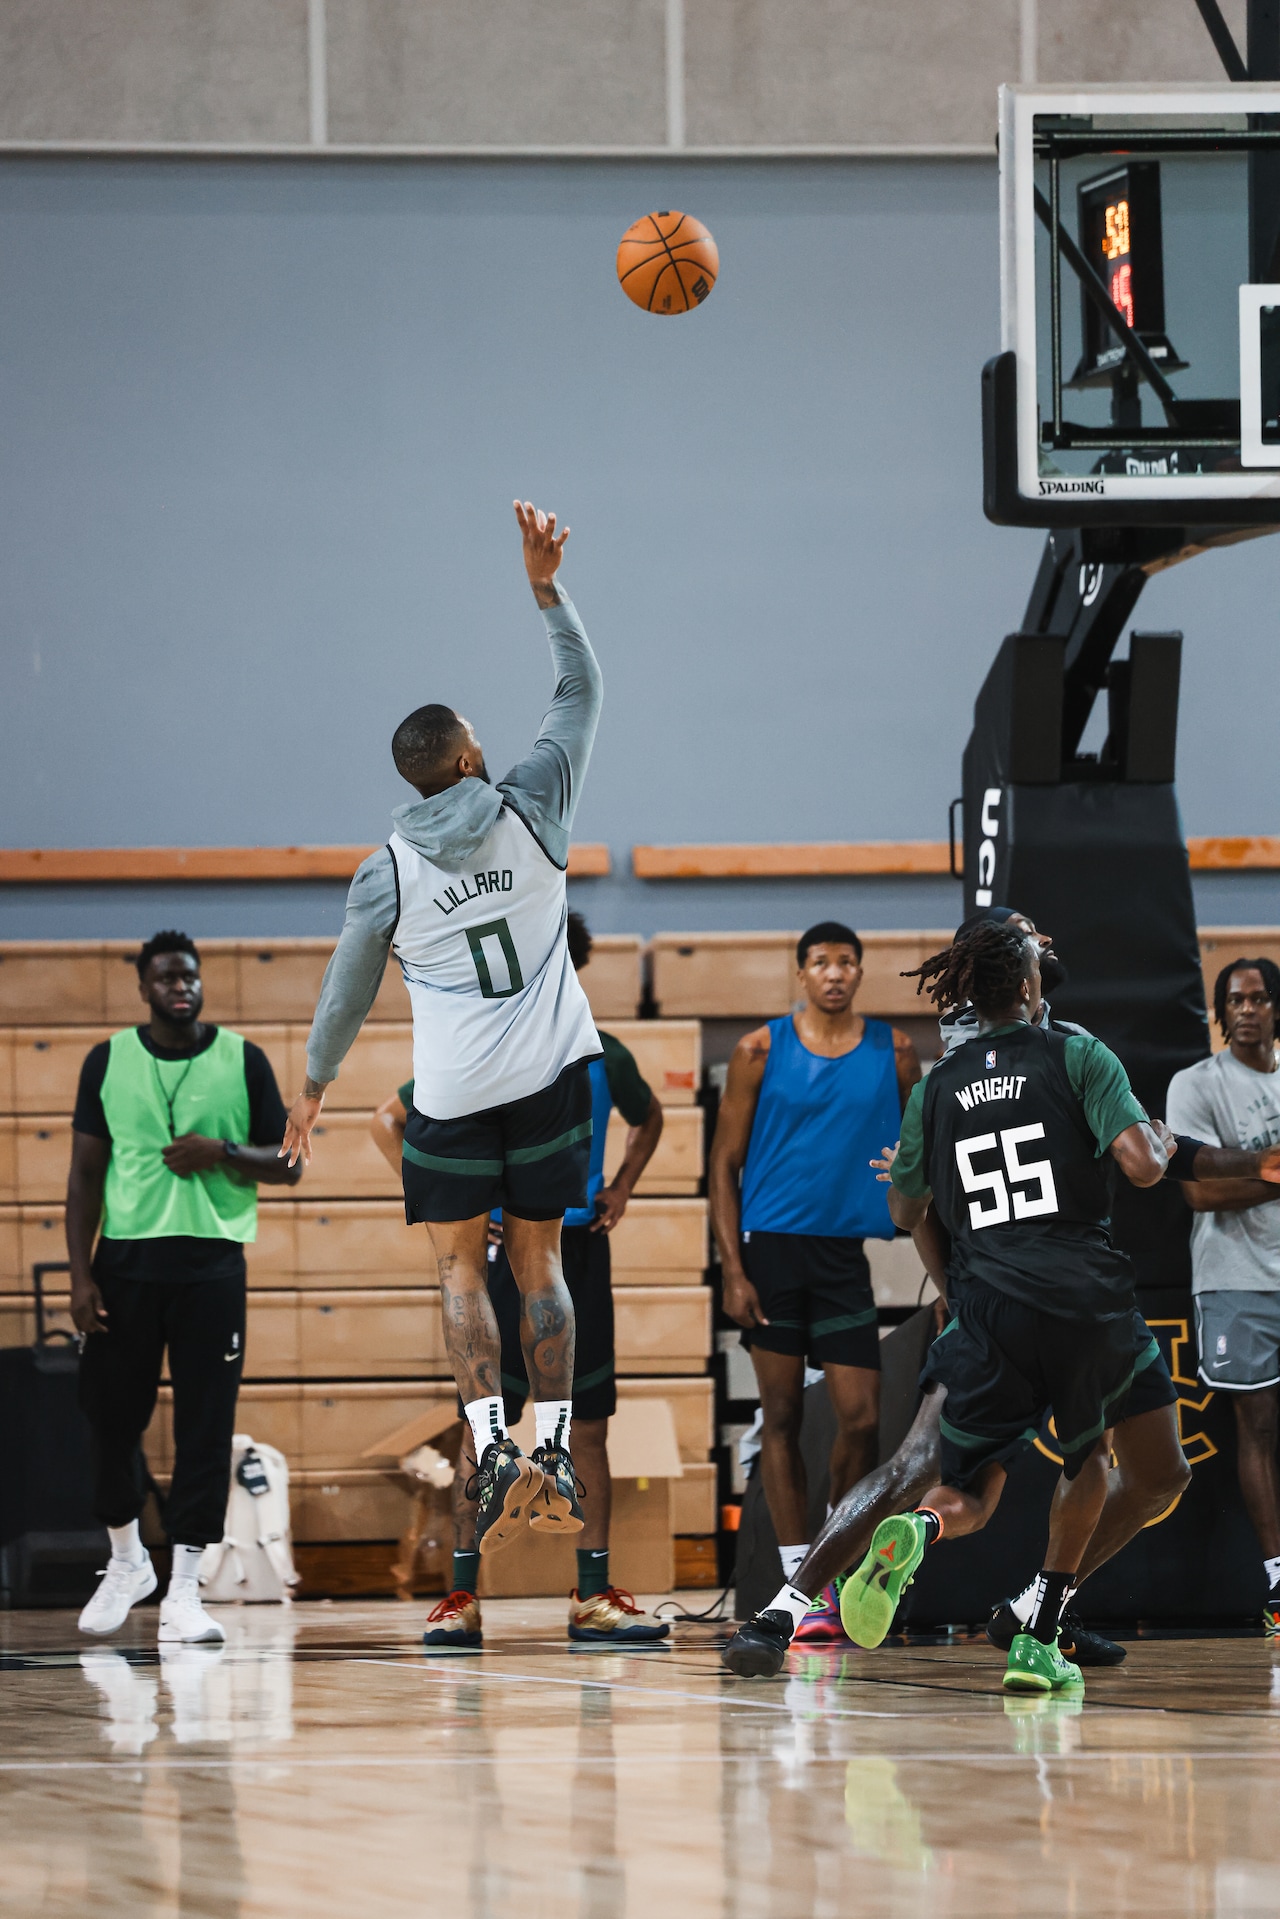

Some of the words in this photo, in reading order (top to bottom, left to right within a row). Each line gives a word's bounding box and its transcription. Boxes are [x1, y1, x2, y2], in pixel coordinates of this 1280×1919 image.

[1039, 480, 1104, 496] SPALDING
[433, 869, 513, 915] LILLARD
[465, 917, 525, 999] 0
[955, 1075, 1027, 1112] WRIGHT
[955, 1122, 1059, 1230] 55
